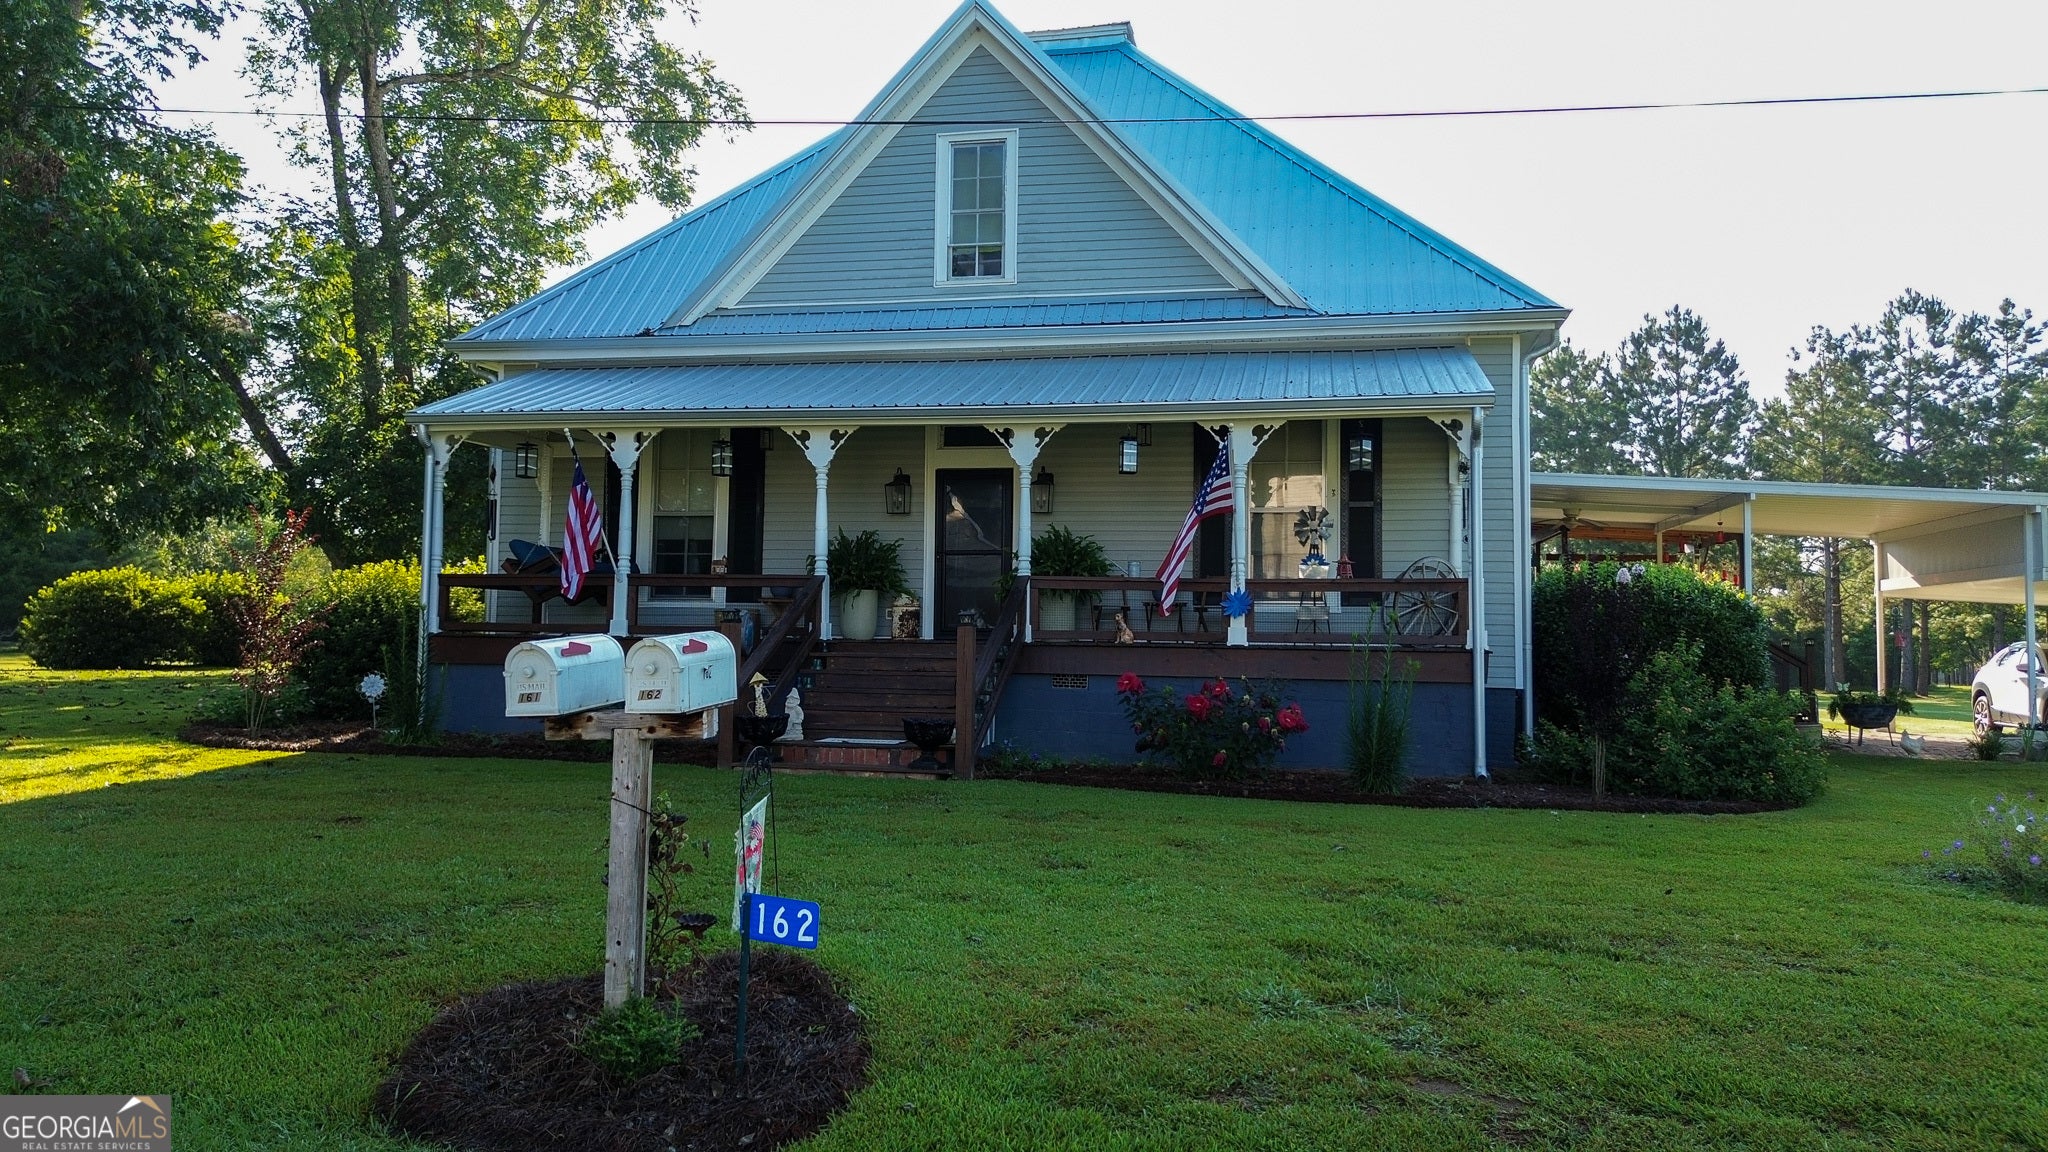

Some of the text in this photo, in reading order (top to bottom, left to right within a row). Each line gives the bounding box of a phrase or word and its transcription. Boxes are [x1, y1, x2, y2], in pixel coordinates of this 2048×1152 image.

[520, 692, 540, 703] 161
[640, 689, 662, 700] 162
[758, 903, 814, 942] 162
